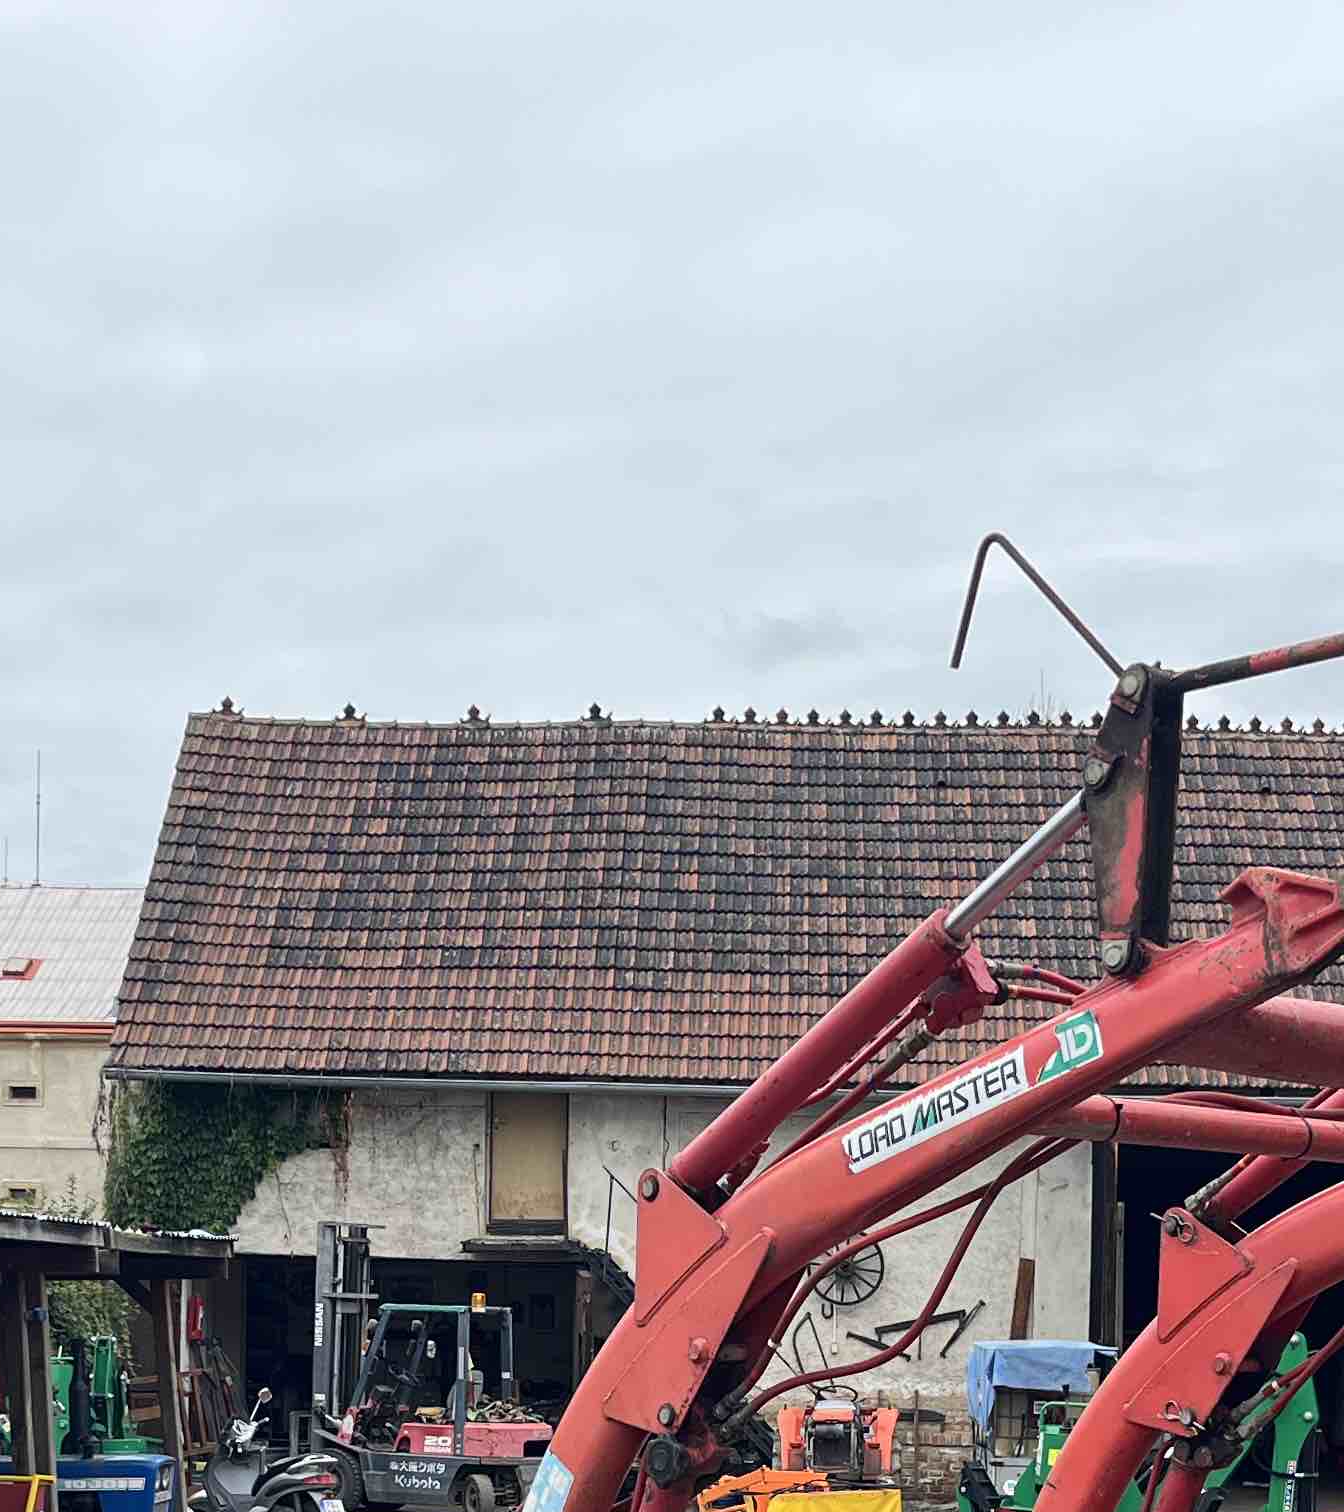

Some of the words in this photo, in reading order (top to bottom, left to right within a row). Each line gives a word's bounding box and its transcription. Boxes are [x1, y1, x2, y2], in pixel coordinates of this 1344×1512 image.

[847, 1113, 907, 1164] LOAD
[910, 1058, 1022, 1137] MASTER
[314, 1303, 324, 1347] NISSAN
[424, 1436, 452, 1447] 20
[394, 1475, 441, 1490] Kubota
